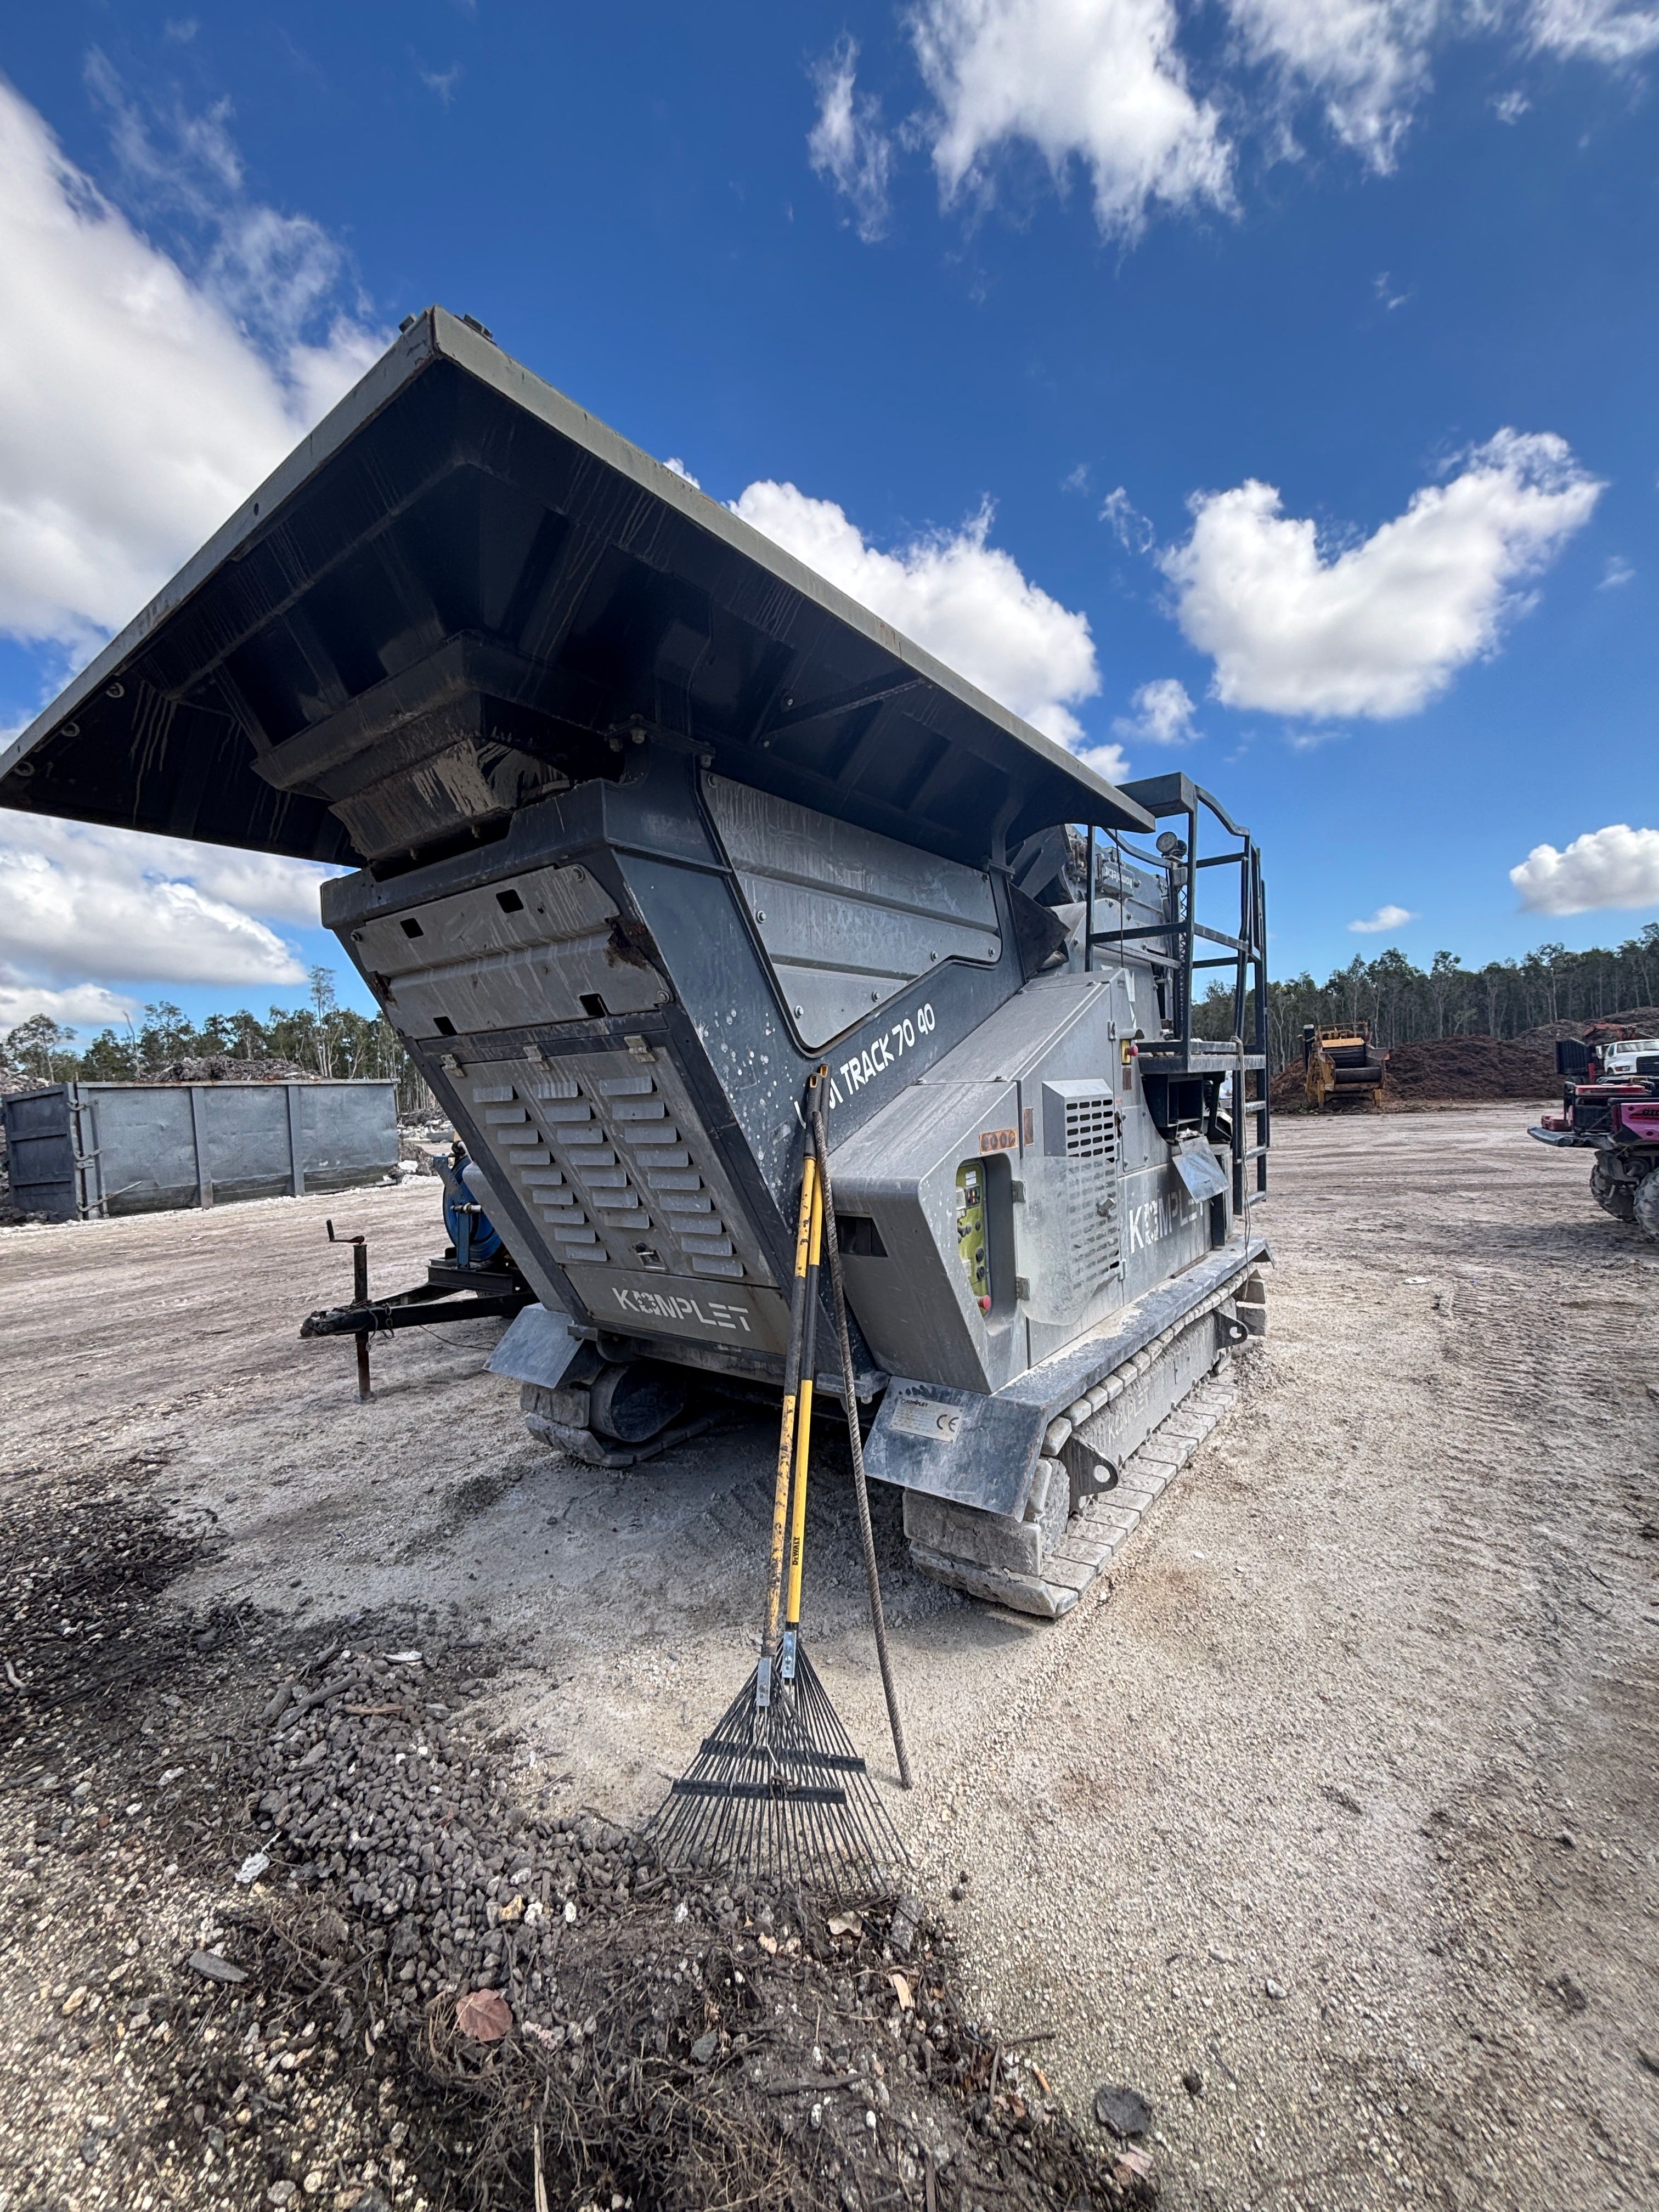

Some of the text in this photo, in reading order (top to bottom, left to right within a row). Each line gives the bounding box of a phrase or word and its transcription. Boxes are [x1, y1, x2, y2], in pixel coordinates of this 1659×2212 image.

[840, 1033, 894, 1095] TRACK
[891, 1018, 915, 1056] 70
[917, 1003, 935, 1035] 40
[611, 1287, 751, 1331] KOMPLET
